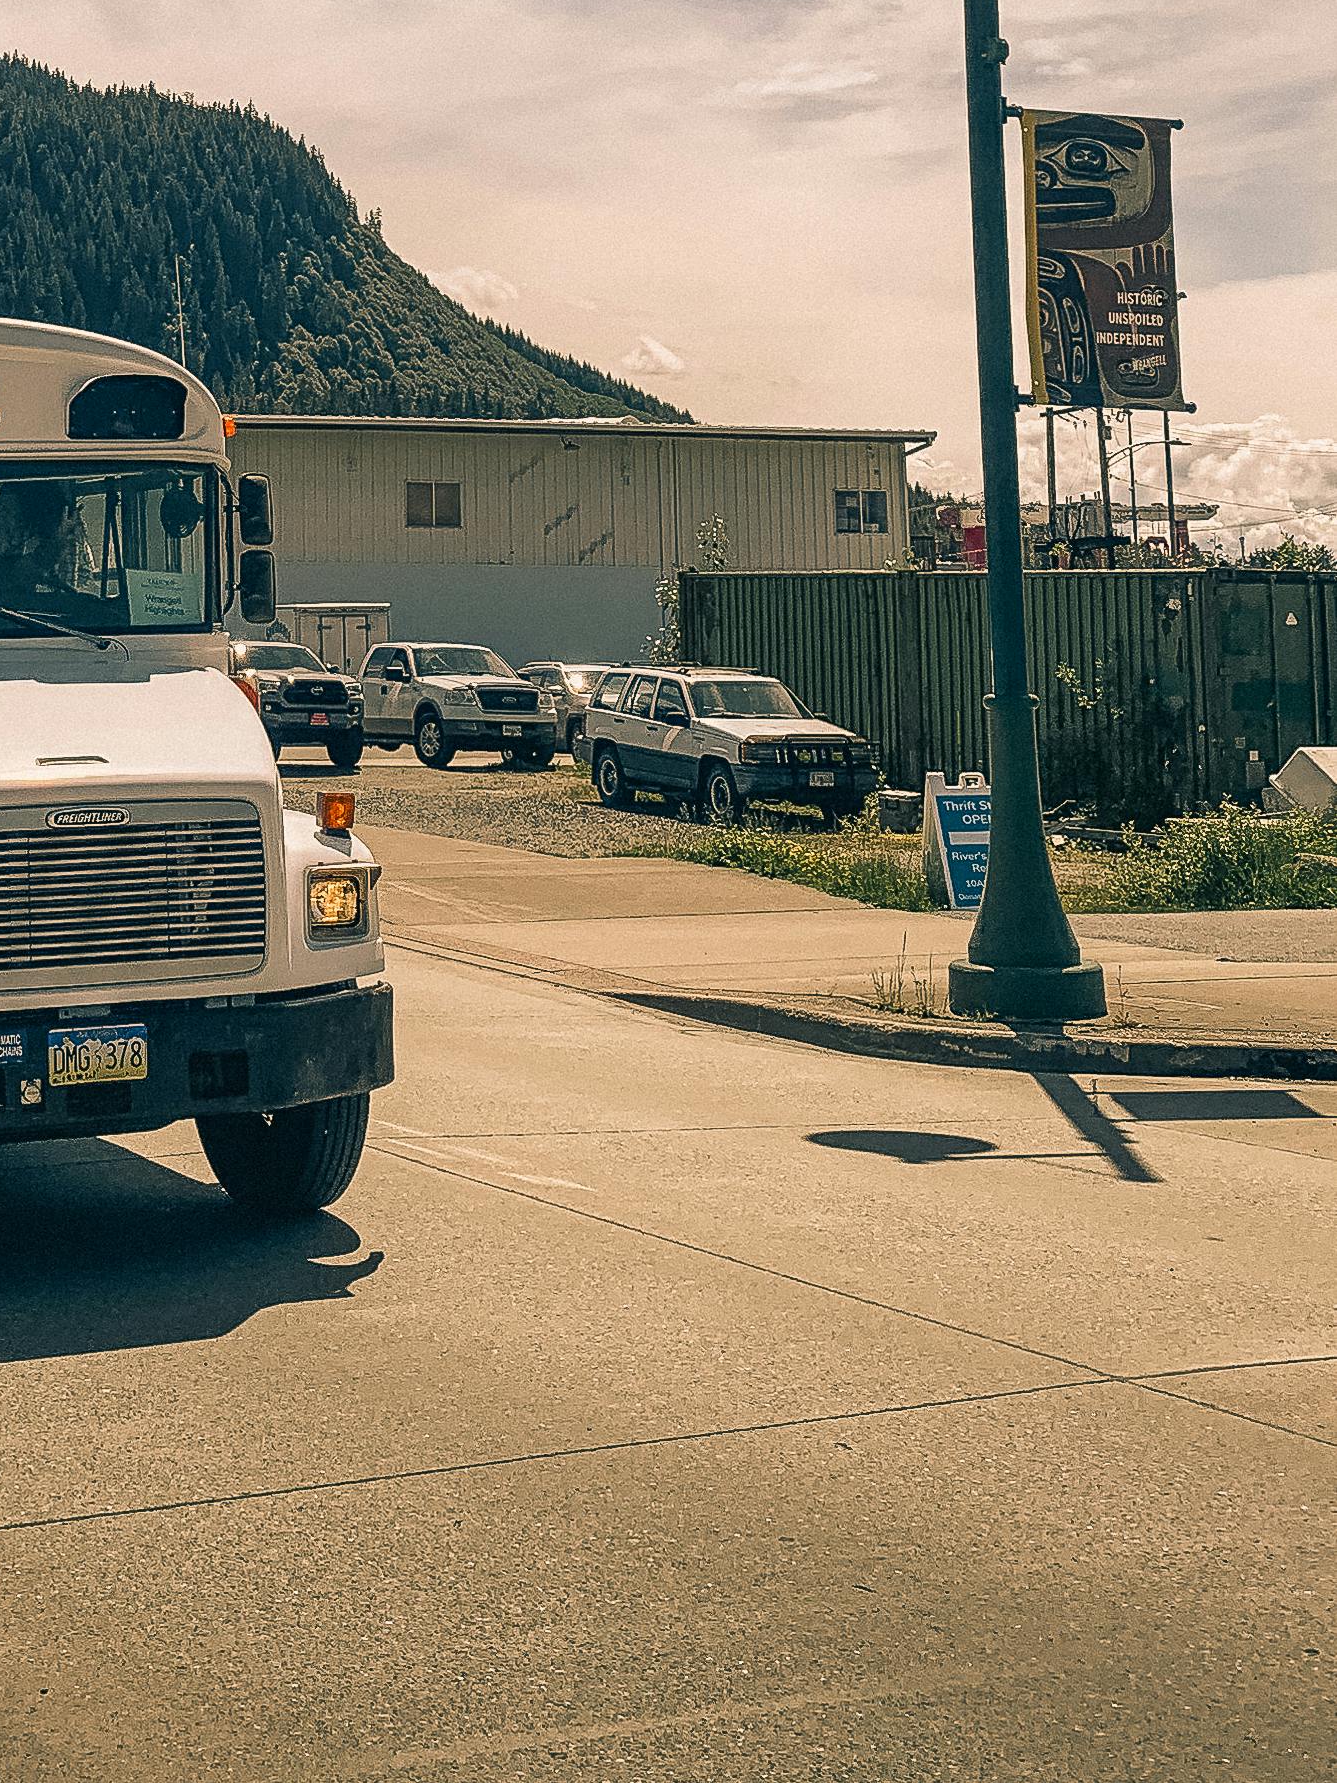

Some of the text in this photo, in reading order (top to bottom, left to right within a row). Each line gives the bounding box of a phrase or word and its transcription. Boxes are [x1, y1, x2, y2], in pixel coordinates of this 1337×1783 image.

[1117, 291, 1163, 307] HISTORIC
[1108, 311, 1164, 327] UNSPOILED
[1096, 331, 1165, 347] INDEPENDENT
[942, 800, 977, 812] Thrift
[56, 812, 123, 824] FREIGHTLINER
[952, 851, 988, 861] River's
[53, 1040, 142, 1074] DMG 378
